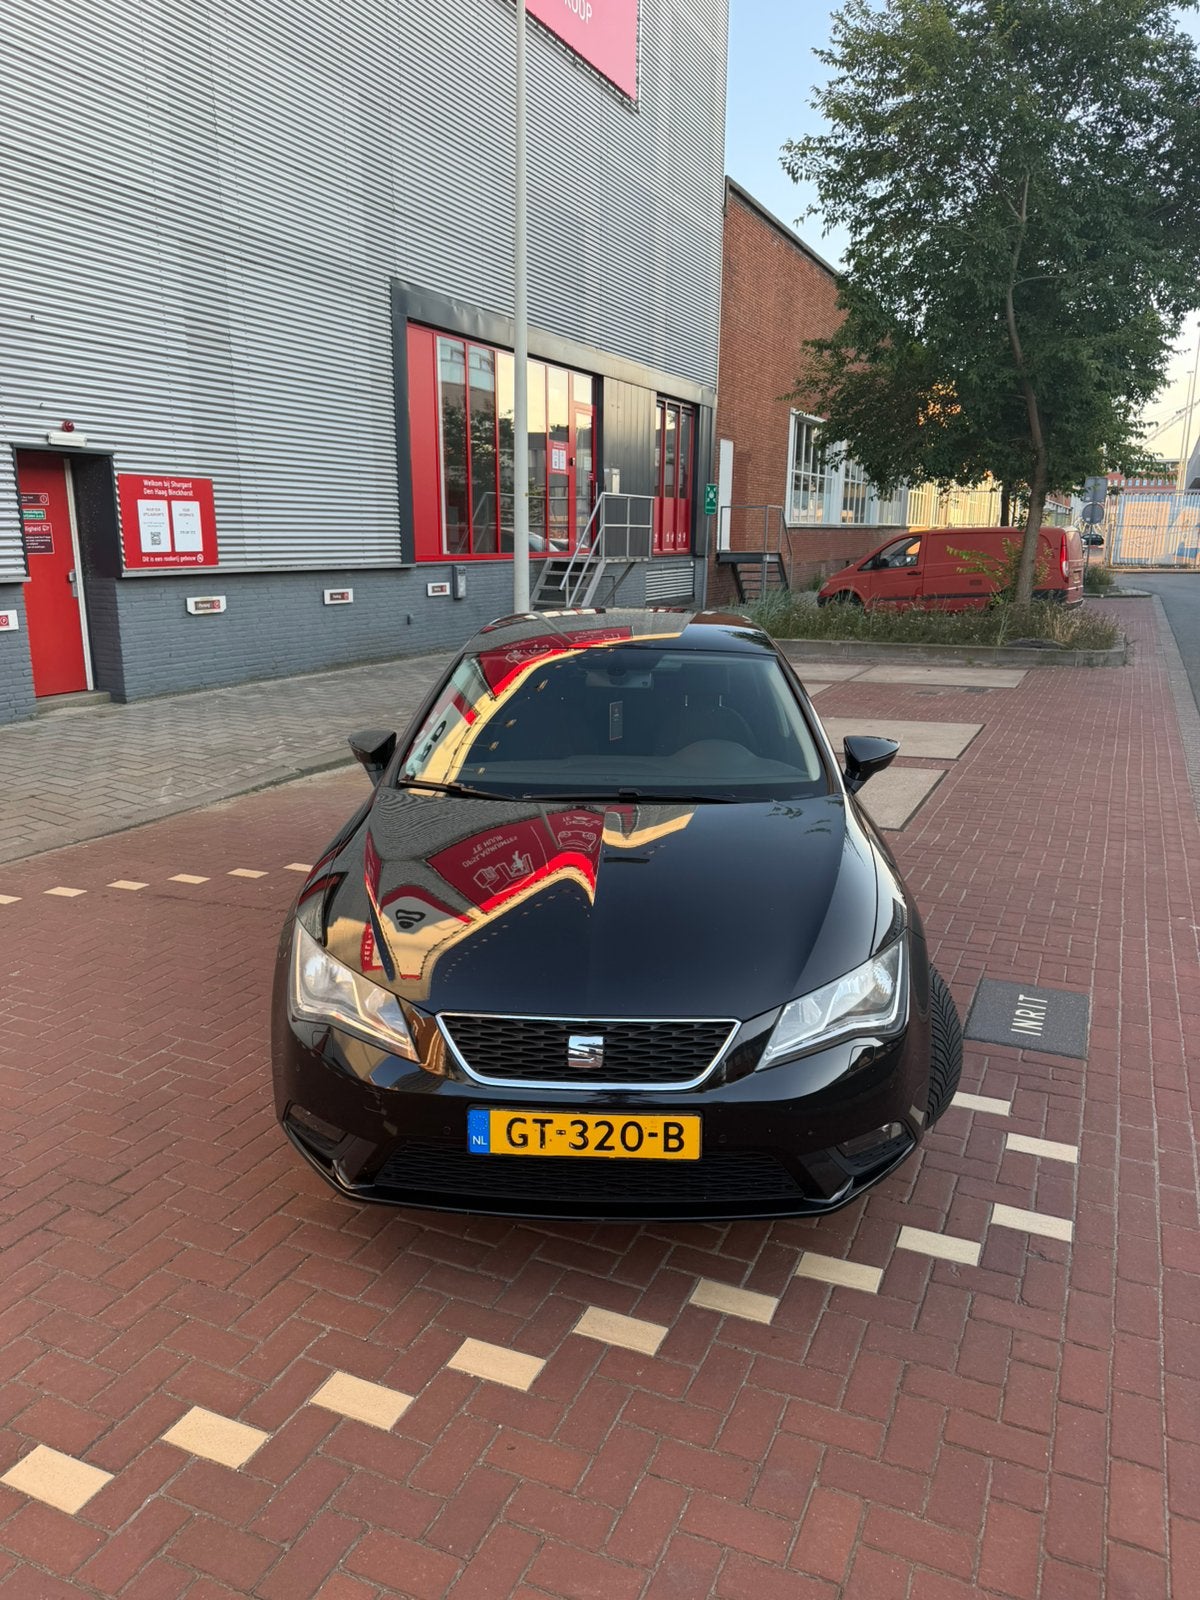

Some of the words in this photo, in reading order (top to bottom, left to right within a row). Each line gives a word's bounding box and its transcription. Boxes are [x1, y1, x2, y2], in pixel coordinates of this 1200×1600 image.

[143, 487, 154, 495] Den
[154, 488, 168, 497] Haag
[170, 480, 193, 489] Shurgard
[1010, 994, 1048, 1036] INRIT
[472, 1135, 488, 1146] NL
[506, 1117, 684, 1152] GT-320-B
